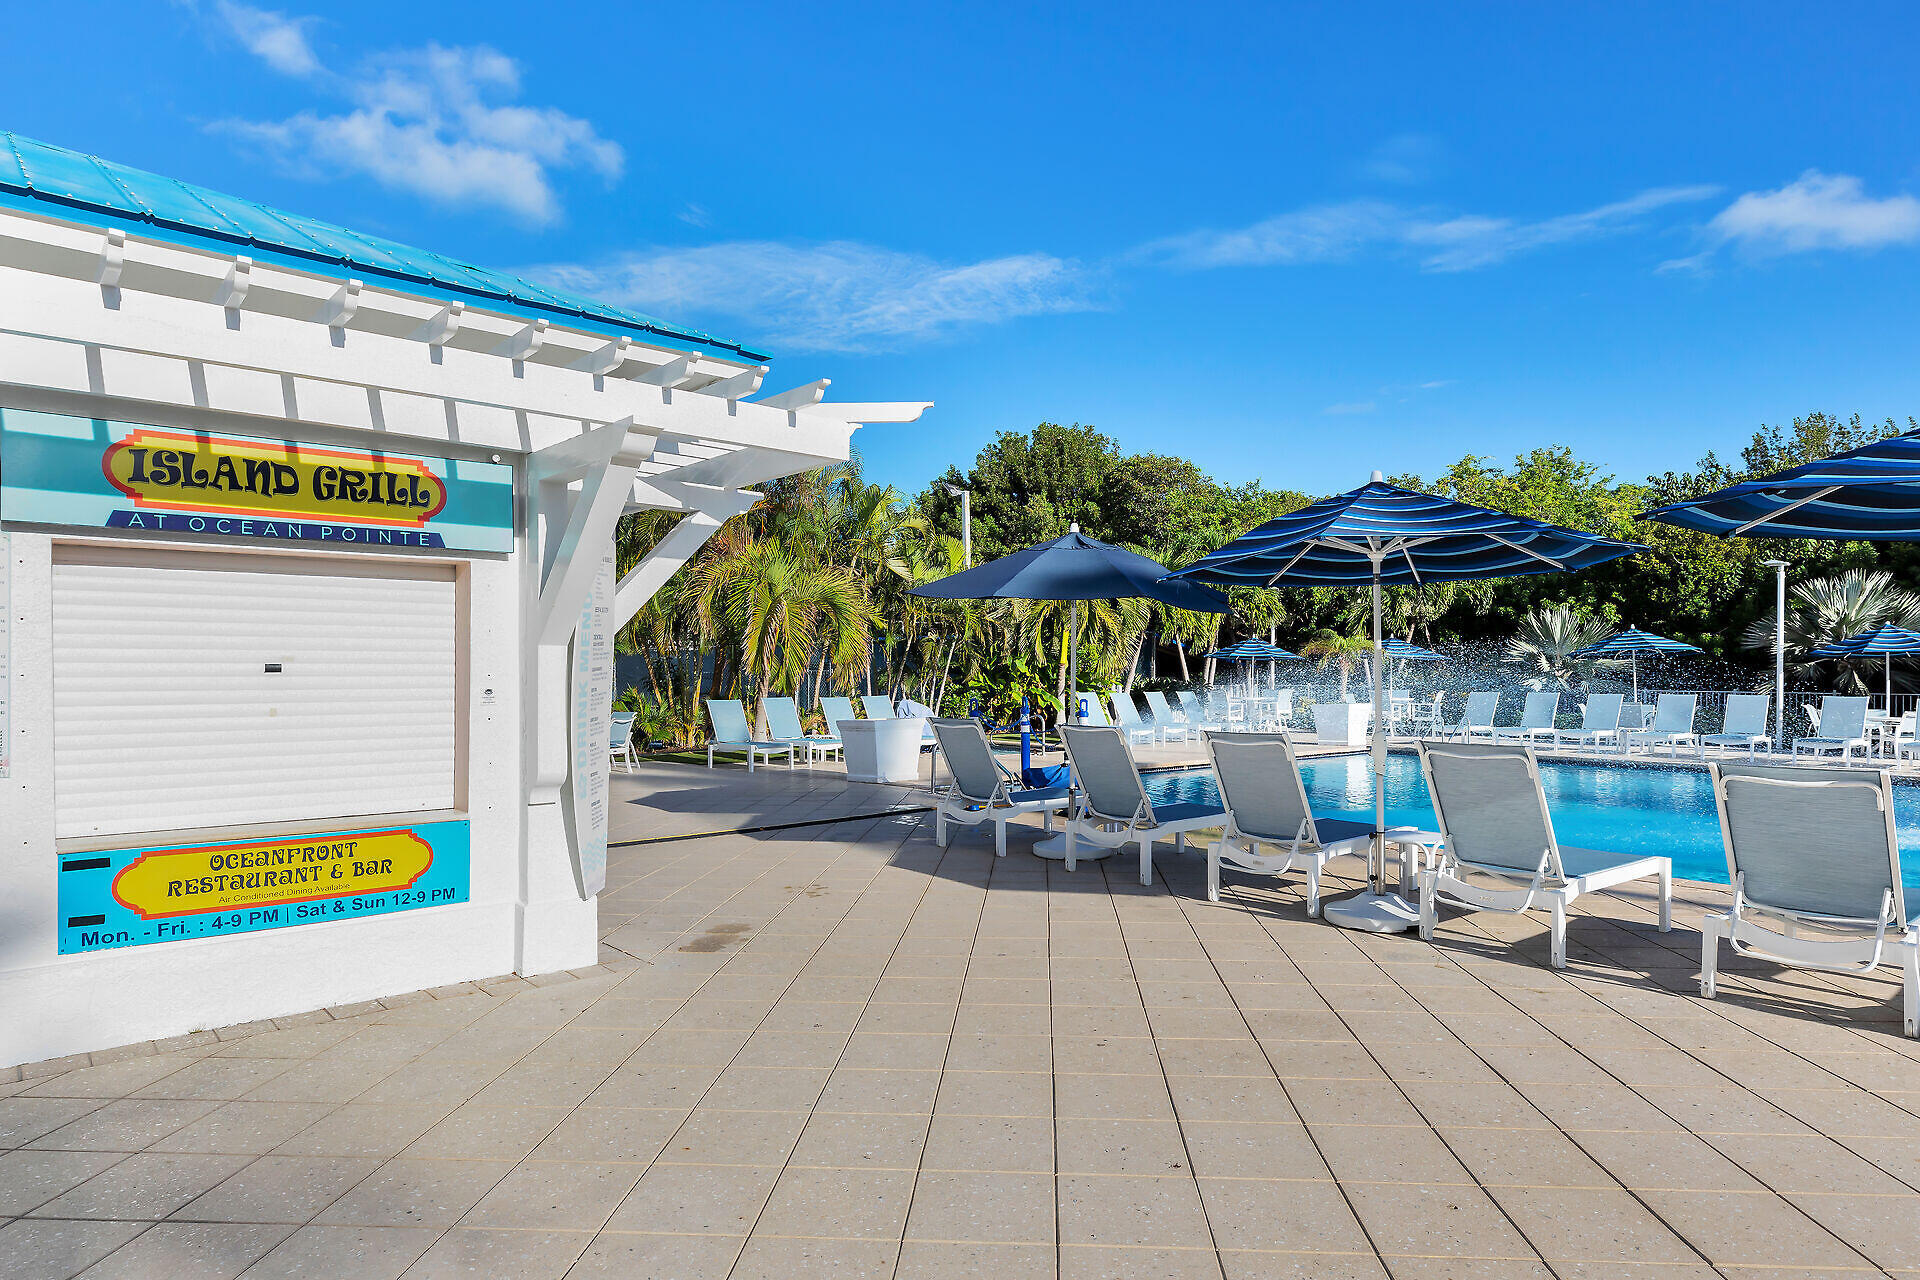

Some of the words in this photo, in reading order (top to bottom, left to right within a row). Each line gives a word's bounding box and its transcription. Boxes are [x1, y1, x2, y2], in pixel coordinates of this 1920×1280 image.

[128, 448, 300, 498] ISLAND
[312, 465, 431, 508] GRILL
[128, 513, 168, 529] AT
[188, 517, 302, 539] OCEAN
[321, 526, 430, 546] POINTE
[576, 680, 589, 769] DRINK
[209, 842, 358, 871] OCEANFRONT
[167, 865, 323, 897] RESTAURANT
[330, 863, 344, 879] &
[352, 858, 393, 877] BAR
[218, 896, 231, 904] Air
[233, 888, 285, 903] Conditioned
[286, 885, 313, 897] Dining
[81, 930, 135, 947] Mon.
[157, 920, 191, 937] Fri.
[211, 913, 242, 930] 4-9
[249, 909, 279, 925] PM
[296, 902, 327, 919] Sat
[333, 900, 346, 913] &
[351, 898, 385, 911] Sun
[392, 890, 426, 907] 12-9
[431, 887, 456, 902] PM
